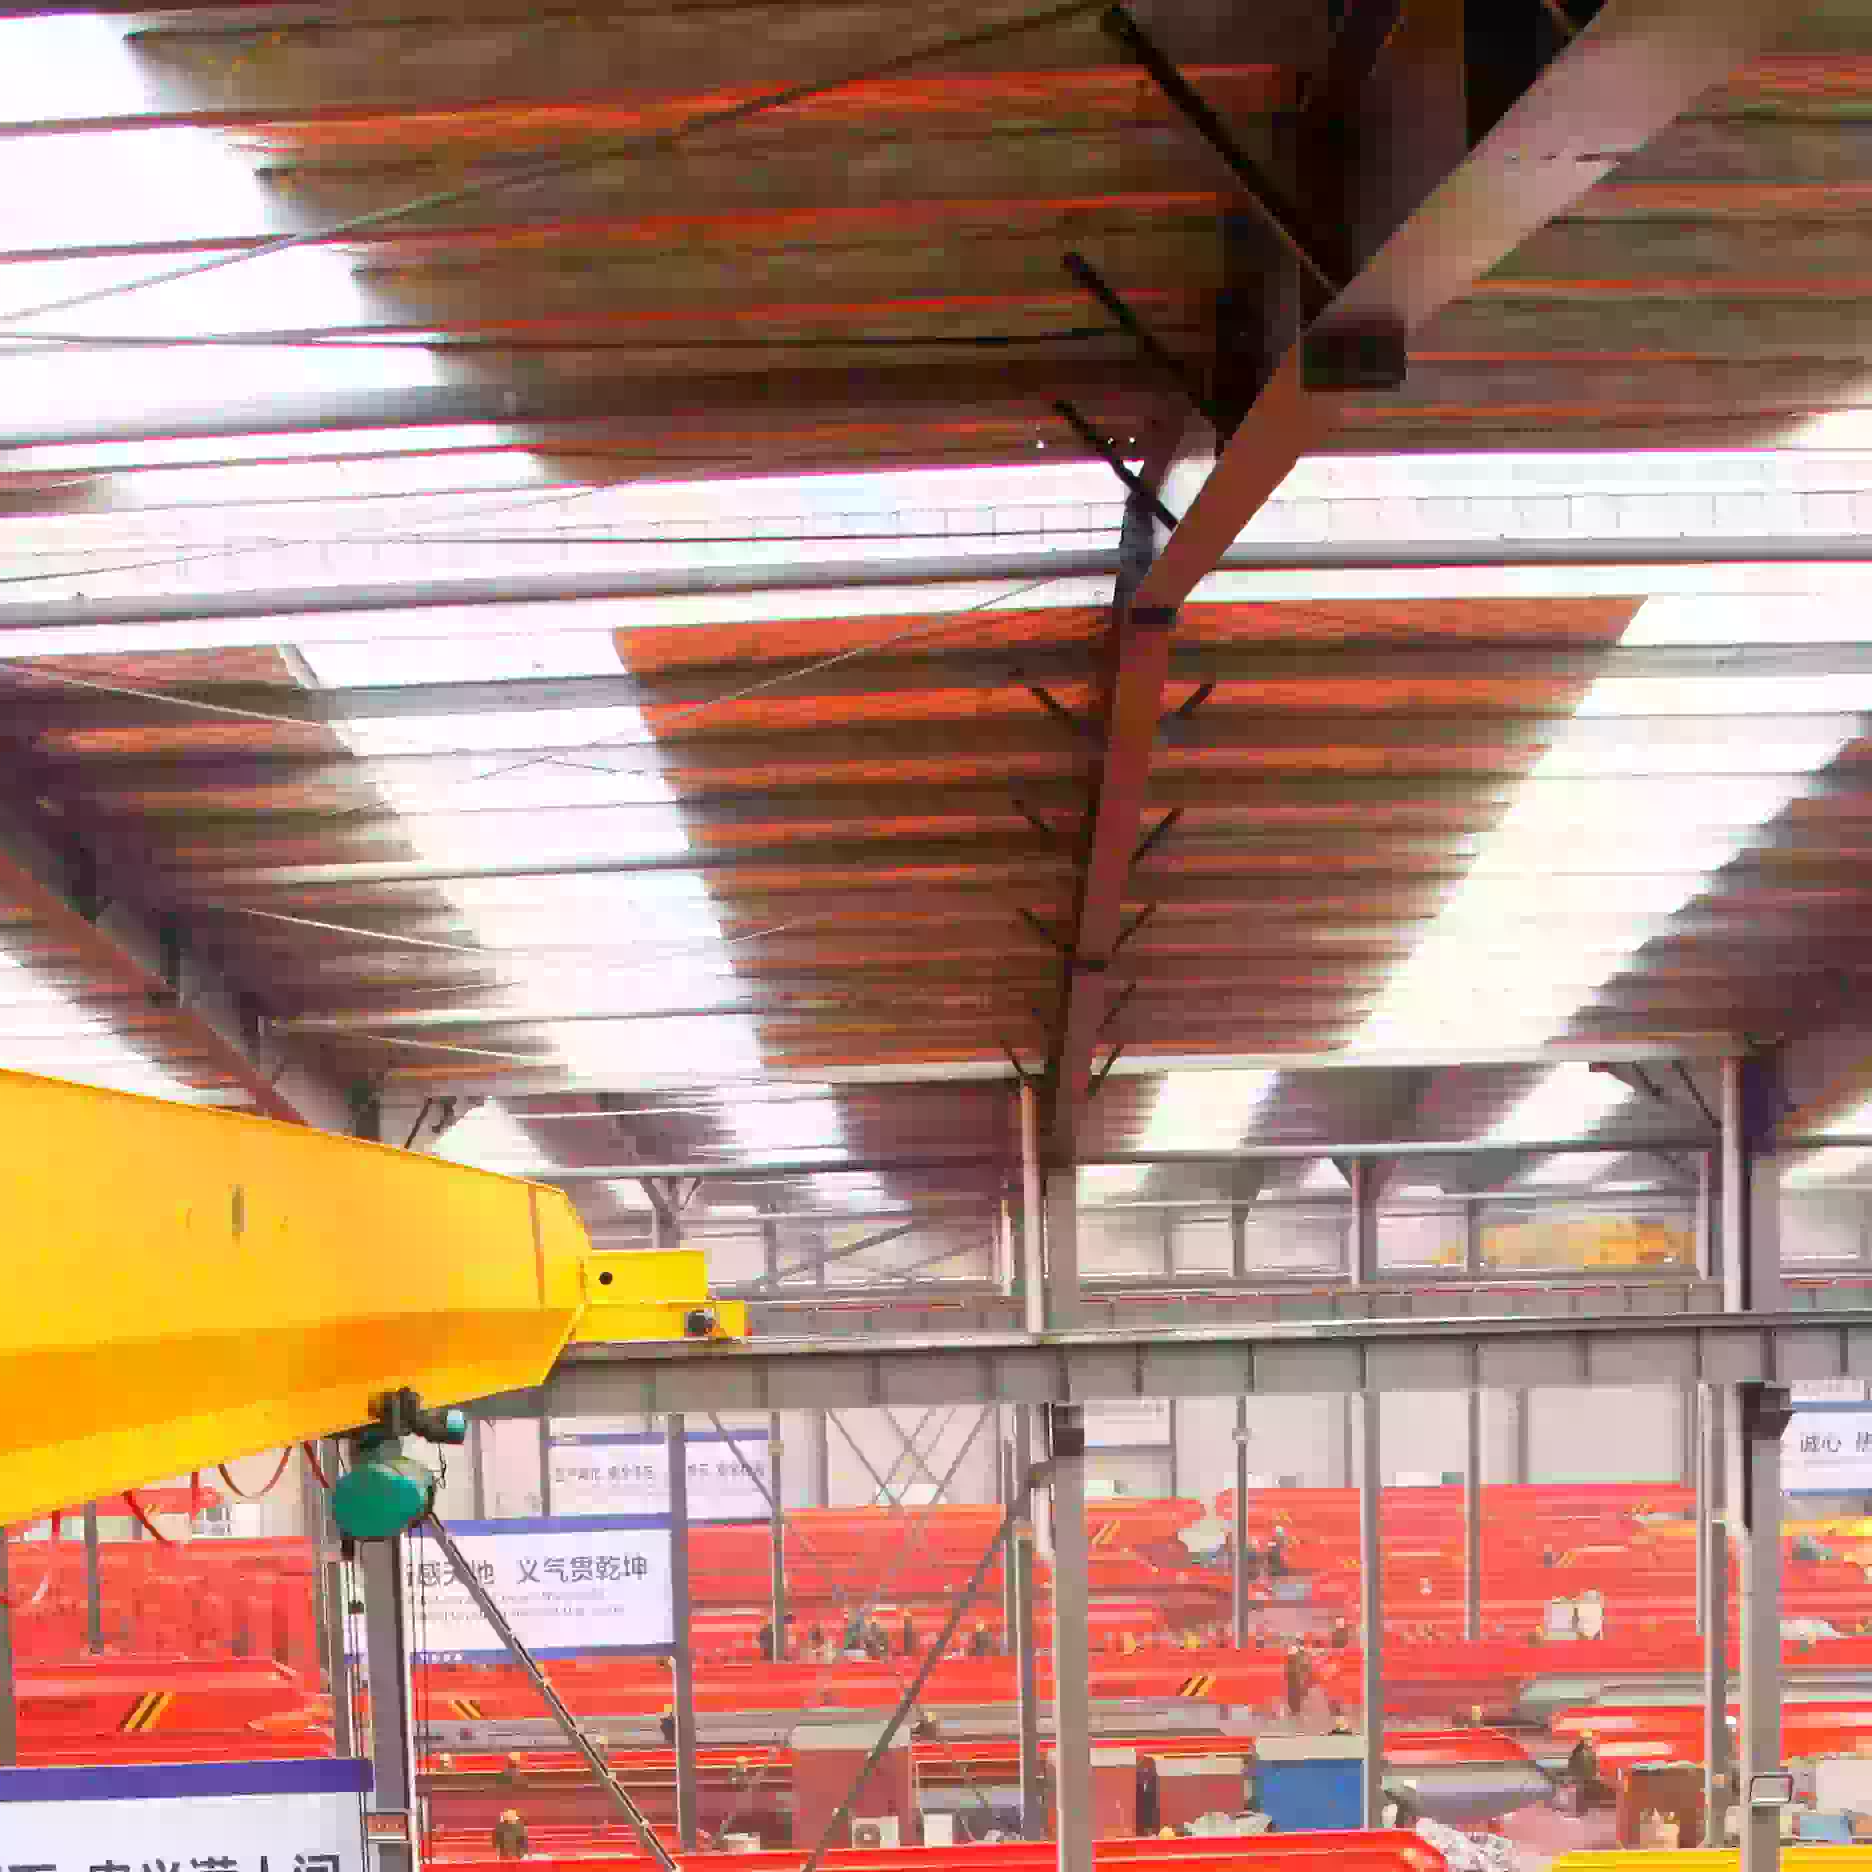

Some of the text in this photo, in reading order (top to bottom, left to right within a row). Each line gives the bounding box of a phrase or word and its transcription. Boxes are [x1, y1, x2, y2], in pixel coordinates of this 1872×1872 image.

[516, 1554, 649, 1585] 义气贯乾坤
